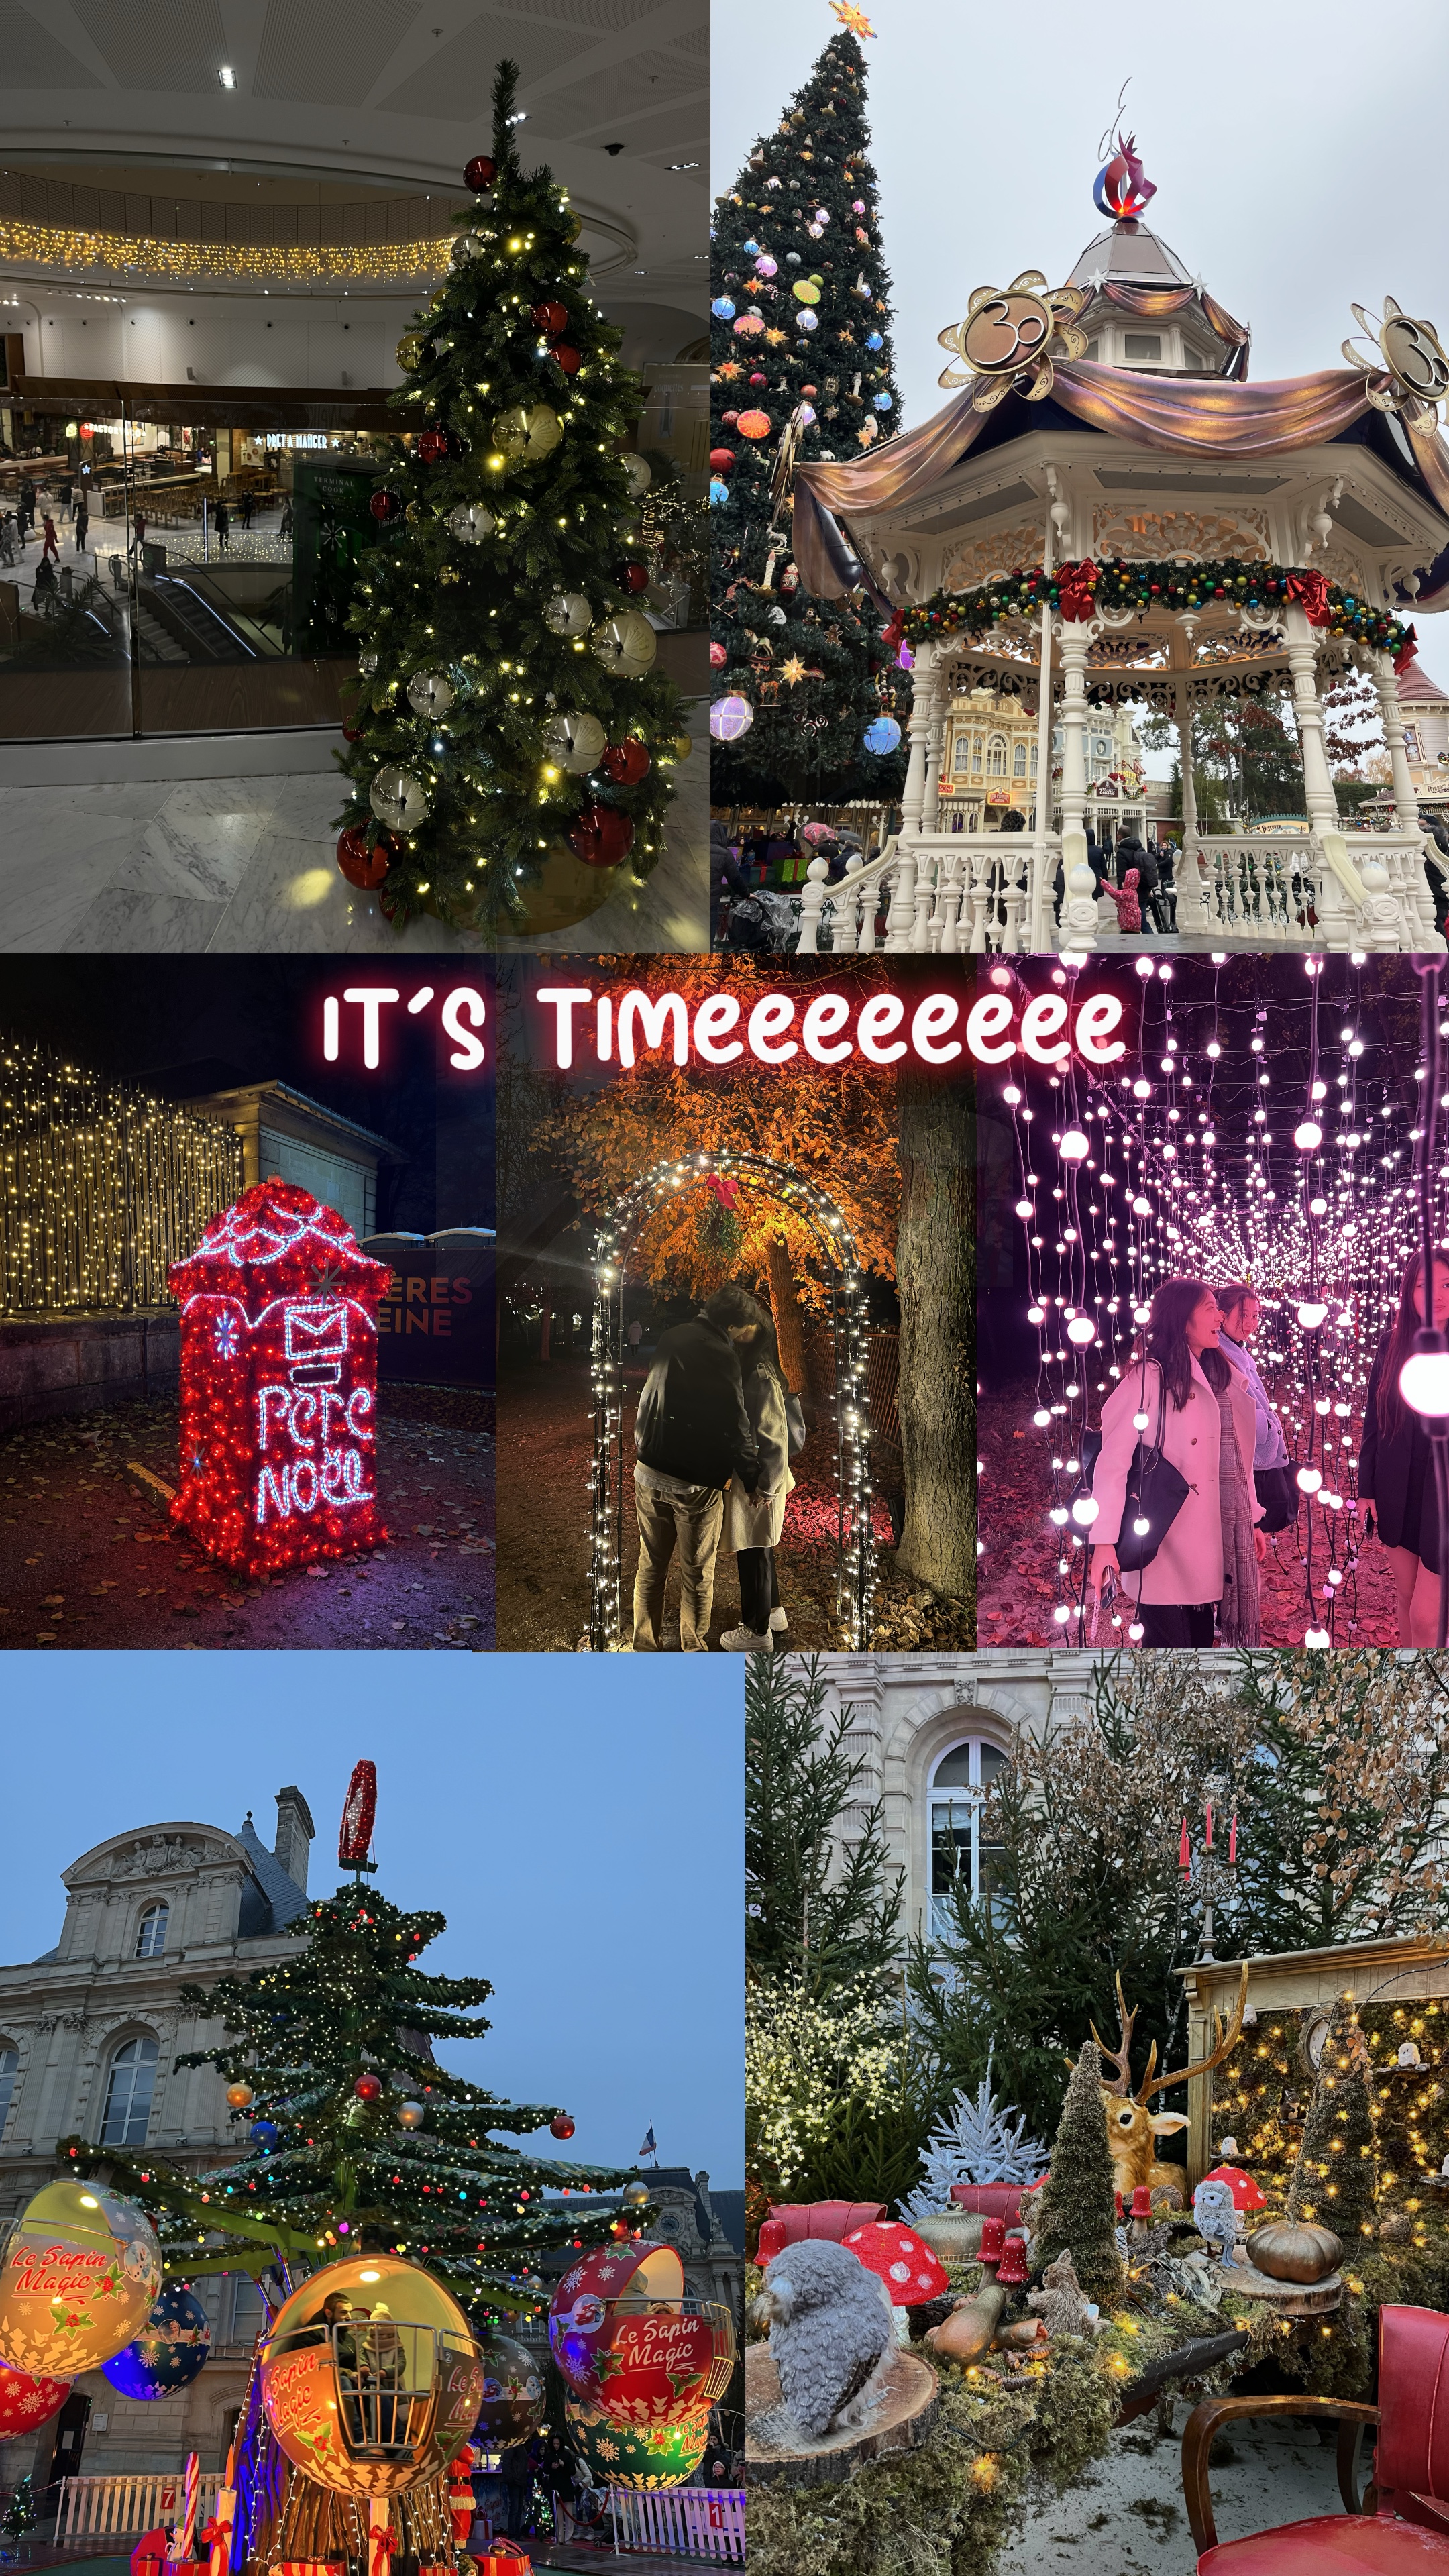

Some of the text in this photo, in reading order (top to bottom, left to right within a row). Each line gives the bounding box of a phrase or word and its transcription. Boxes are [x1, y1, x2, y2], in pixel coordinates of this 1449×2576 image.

[975, 299, 1044, 364] 30
[266, 433, 286, 447] PRET
[287, 434, 294, 448] A
[314, 476, 354, 487] TERMINAL
[322, 486, 344, 494] COOK
[9, 2245, 108, 2272] Le Sapin
[14, 2267, 93, 2300] Magic
[616, 2318, 700, 2345] Le Sapin
[629, 2342, 694, 2373] Magic
[270, 2353, 319, 2398] Sapin
[447, 2365, 468, 2392] Le
[270, 2385, 314, 2431] Magic
[164, 2489, 174, 2508] 7
[712, 2506, 720, 2526] 1
